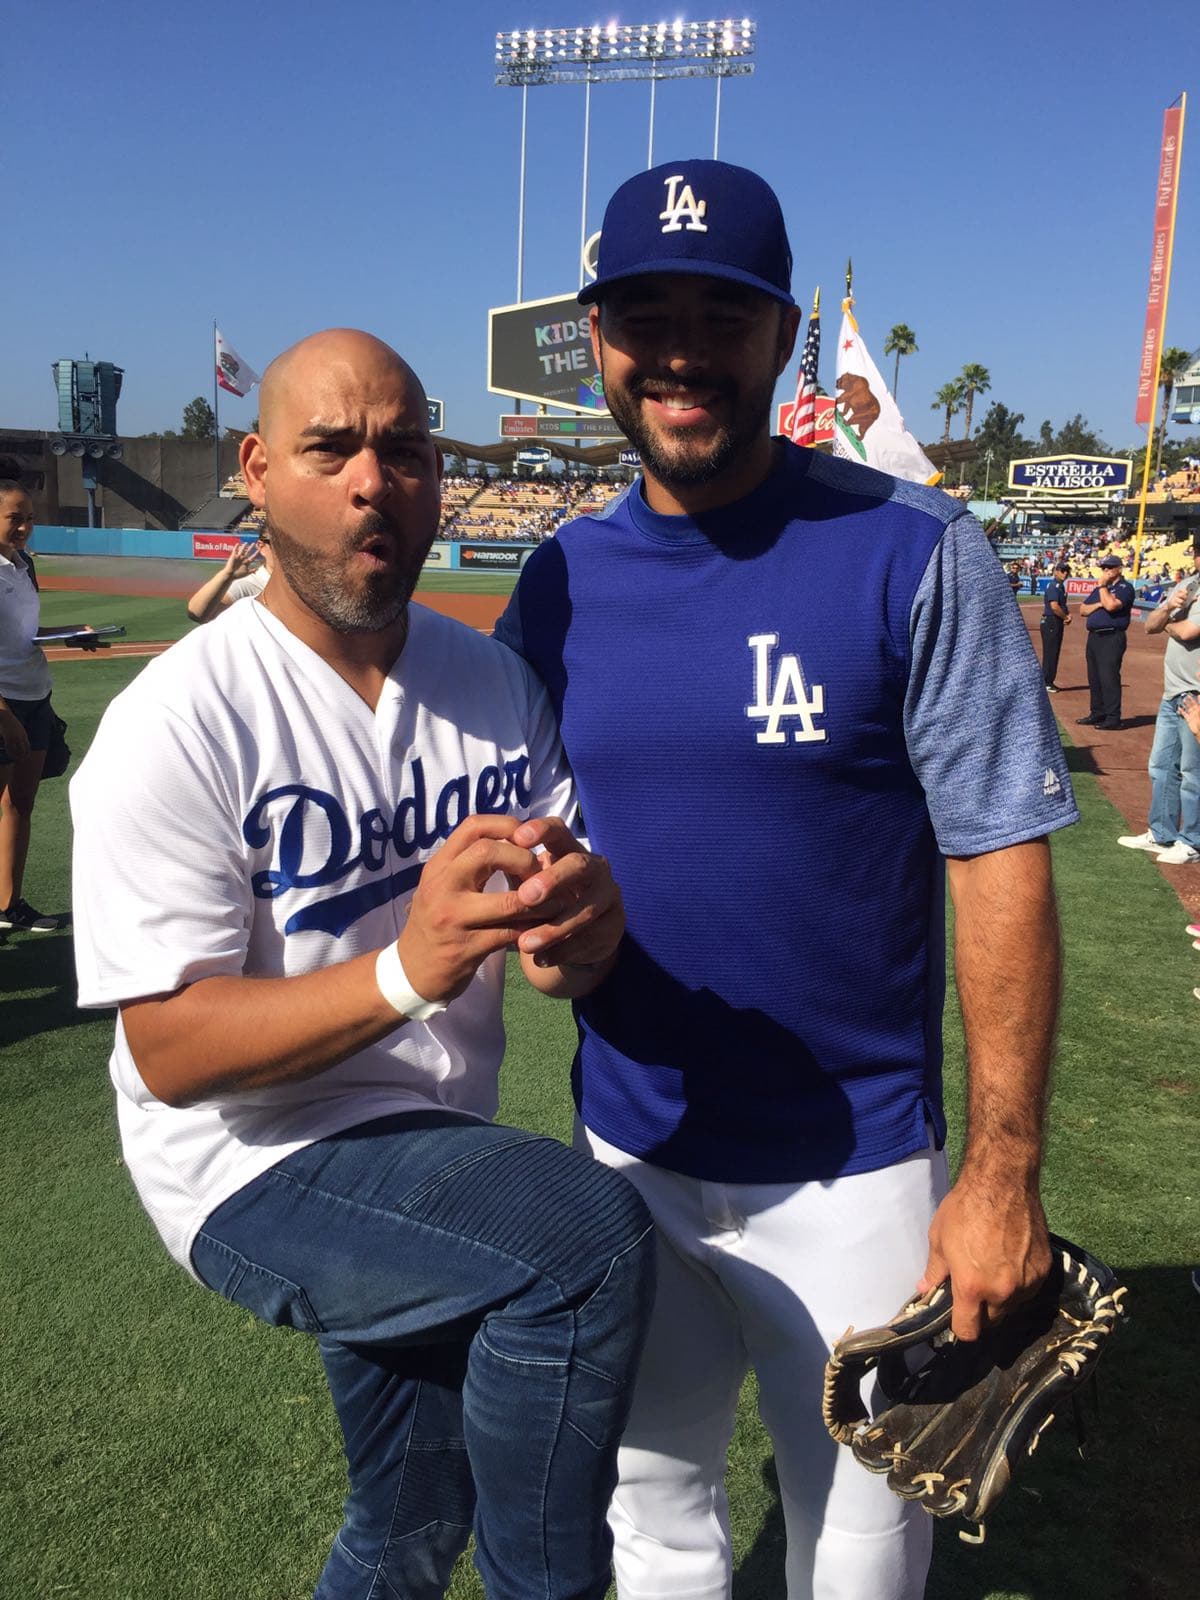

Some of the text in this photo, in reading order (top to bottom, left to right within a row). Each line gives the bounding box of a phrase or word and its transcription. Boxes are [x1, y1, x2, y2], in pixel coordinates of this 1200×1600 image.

[1160, 135, 1176, 185] Emirates
[659, 175, 707, 233] LA
[1148, 232, 1166, 304] Fly Emirates
[534, 317, 591, 347] KIDS
[539, 348, 588, 375] THE
[1138, 328, 1156, 397] Fly Emirates
[1024, 464, 1115, 477] ESTRELLA
[1032, 476, 1105, 488] JALISCO
[195, 542, 214, 550] Bank
[215, 543, 222, 551] of
[1069, 582, 1081, 593] Fly
[747, 633, 826, 744] LA
[243, 754, 531, 899] Dodger
